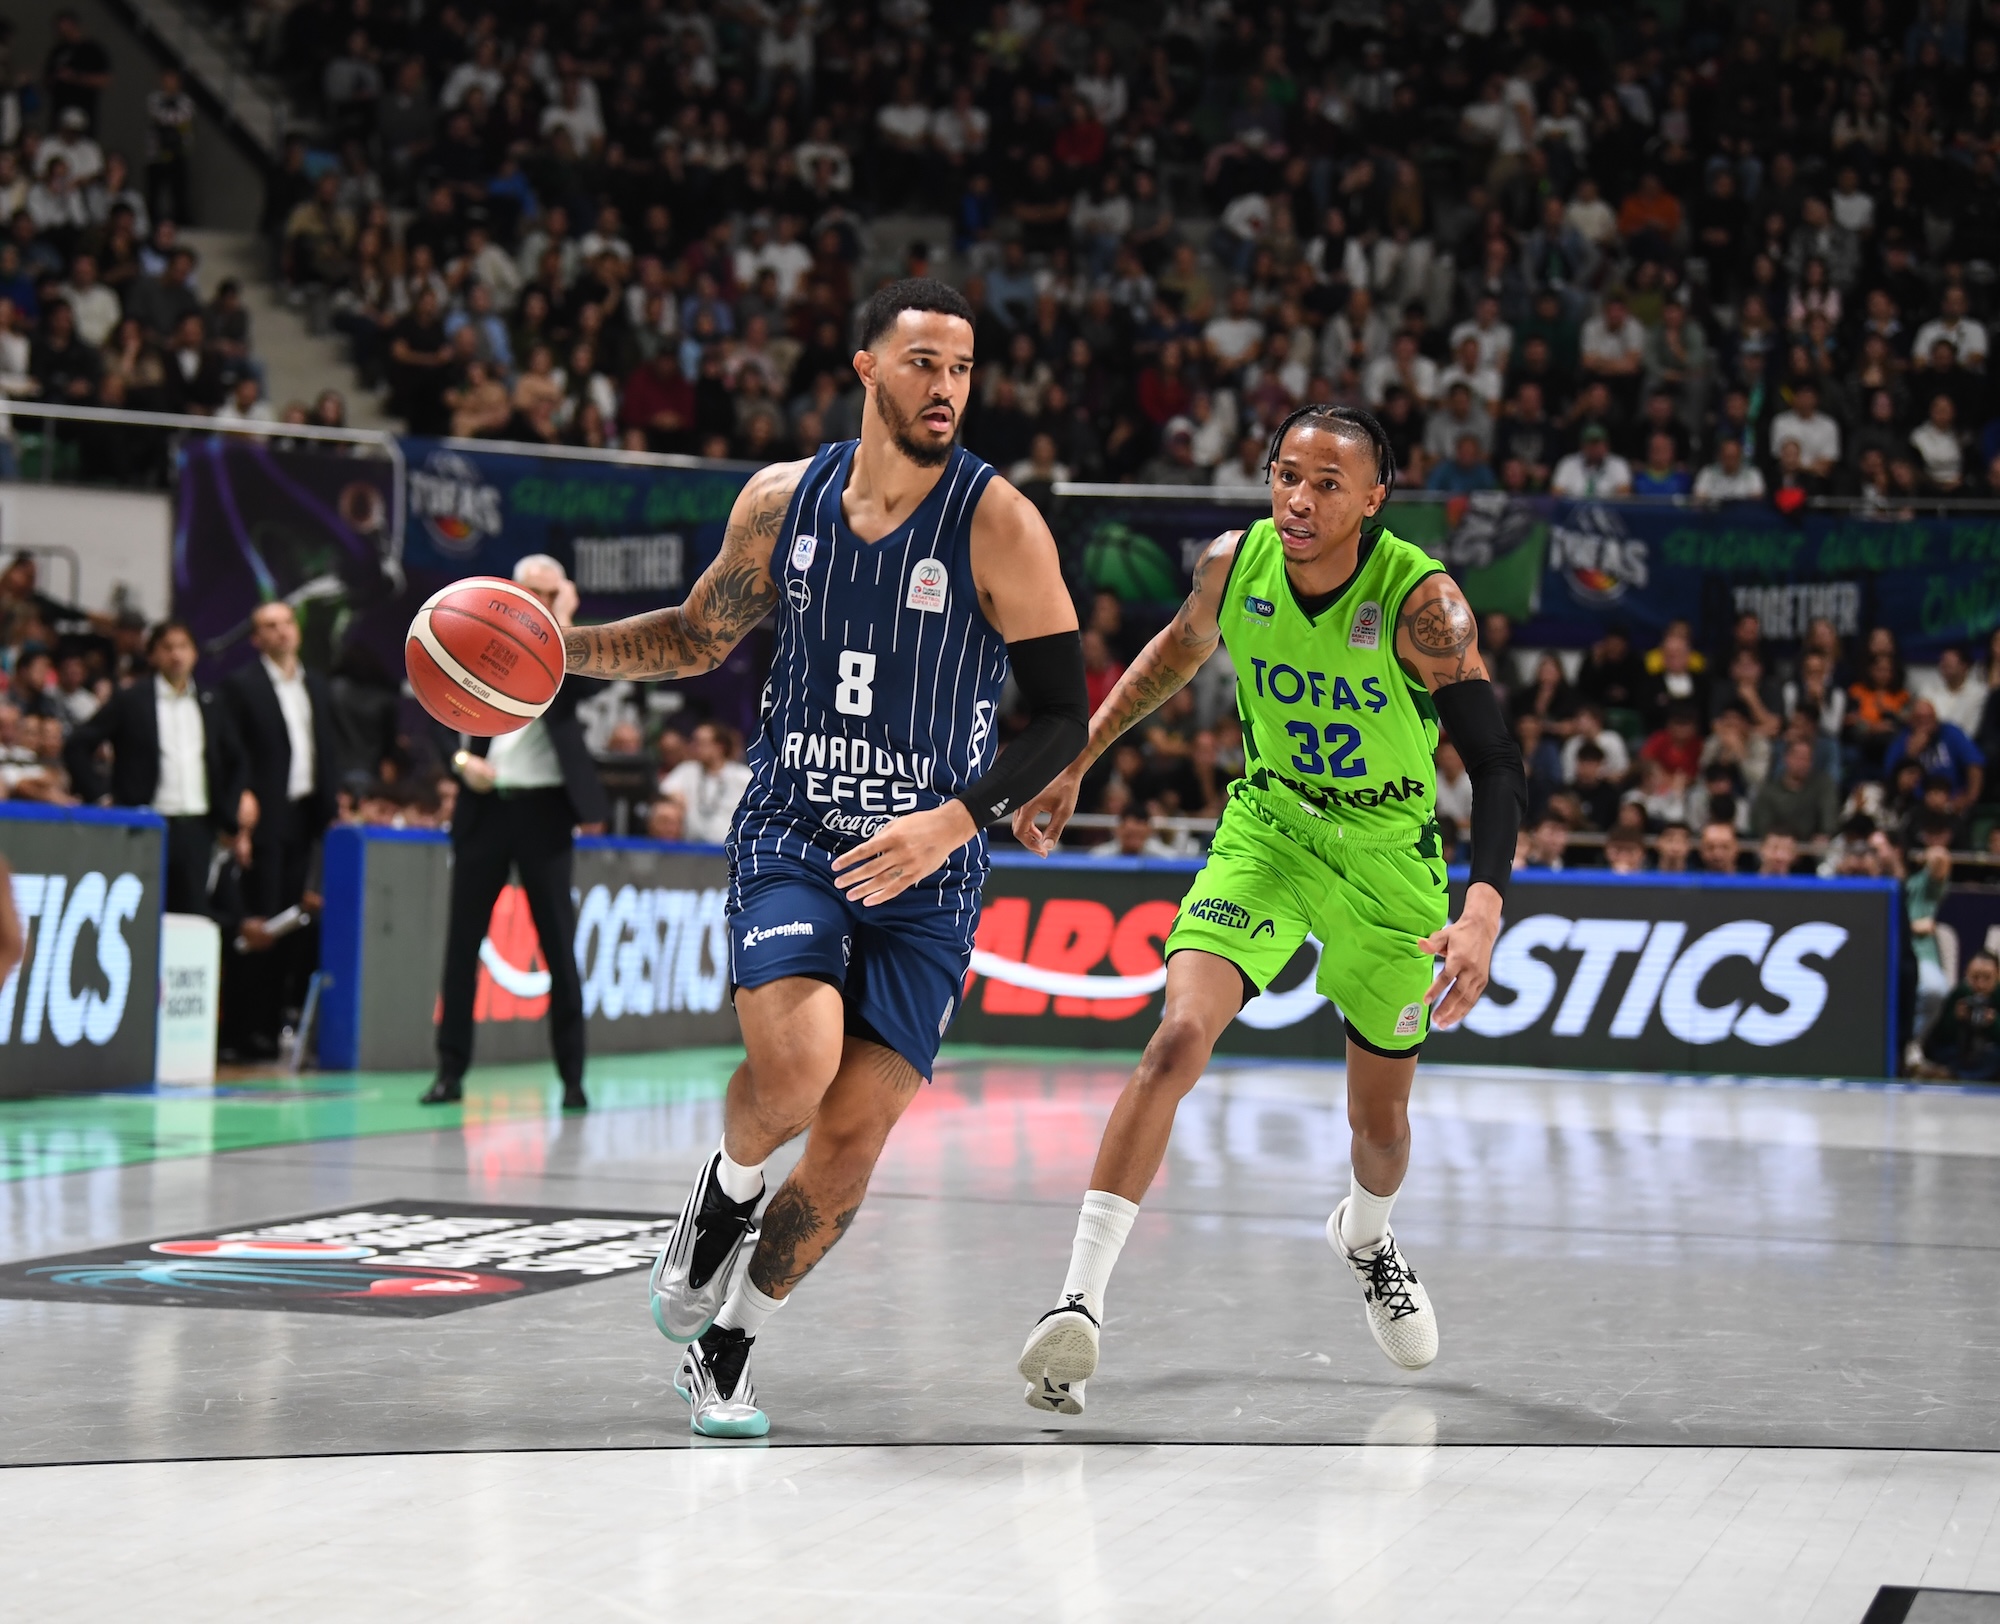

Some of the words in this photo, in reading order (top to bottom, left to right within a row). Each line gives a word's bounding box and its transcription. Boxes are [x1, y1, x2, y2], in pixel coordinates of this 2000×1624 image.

[488, 599, 550, 646] molten
[462, 677, 491, 699] BG4500
[480, 653, 510, 676] APPROVED
[835, 650, 876, 717] 8
[1251, 657, 1388, 713] TOFAŞ
[785, 732, 930, 789] ANADOLU
[1284, 720, 1367, 778] 32
[806, 771, 917, 812] EFES
[570, 884, 730, 1020] OGISTICS
[757, 921, 813, 941] corendon
[963, 898, 1182, 1020] ARS
